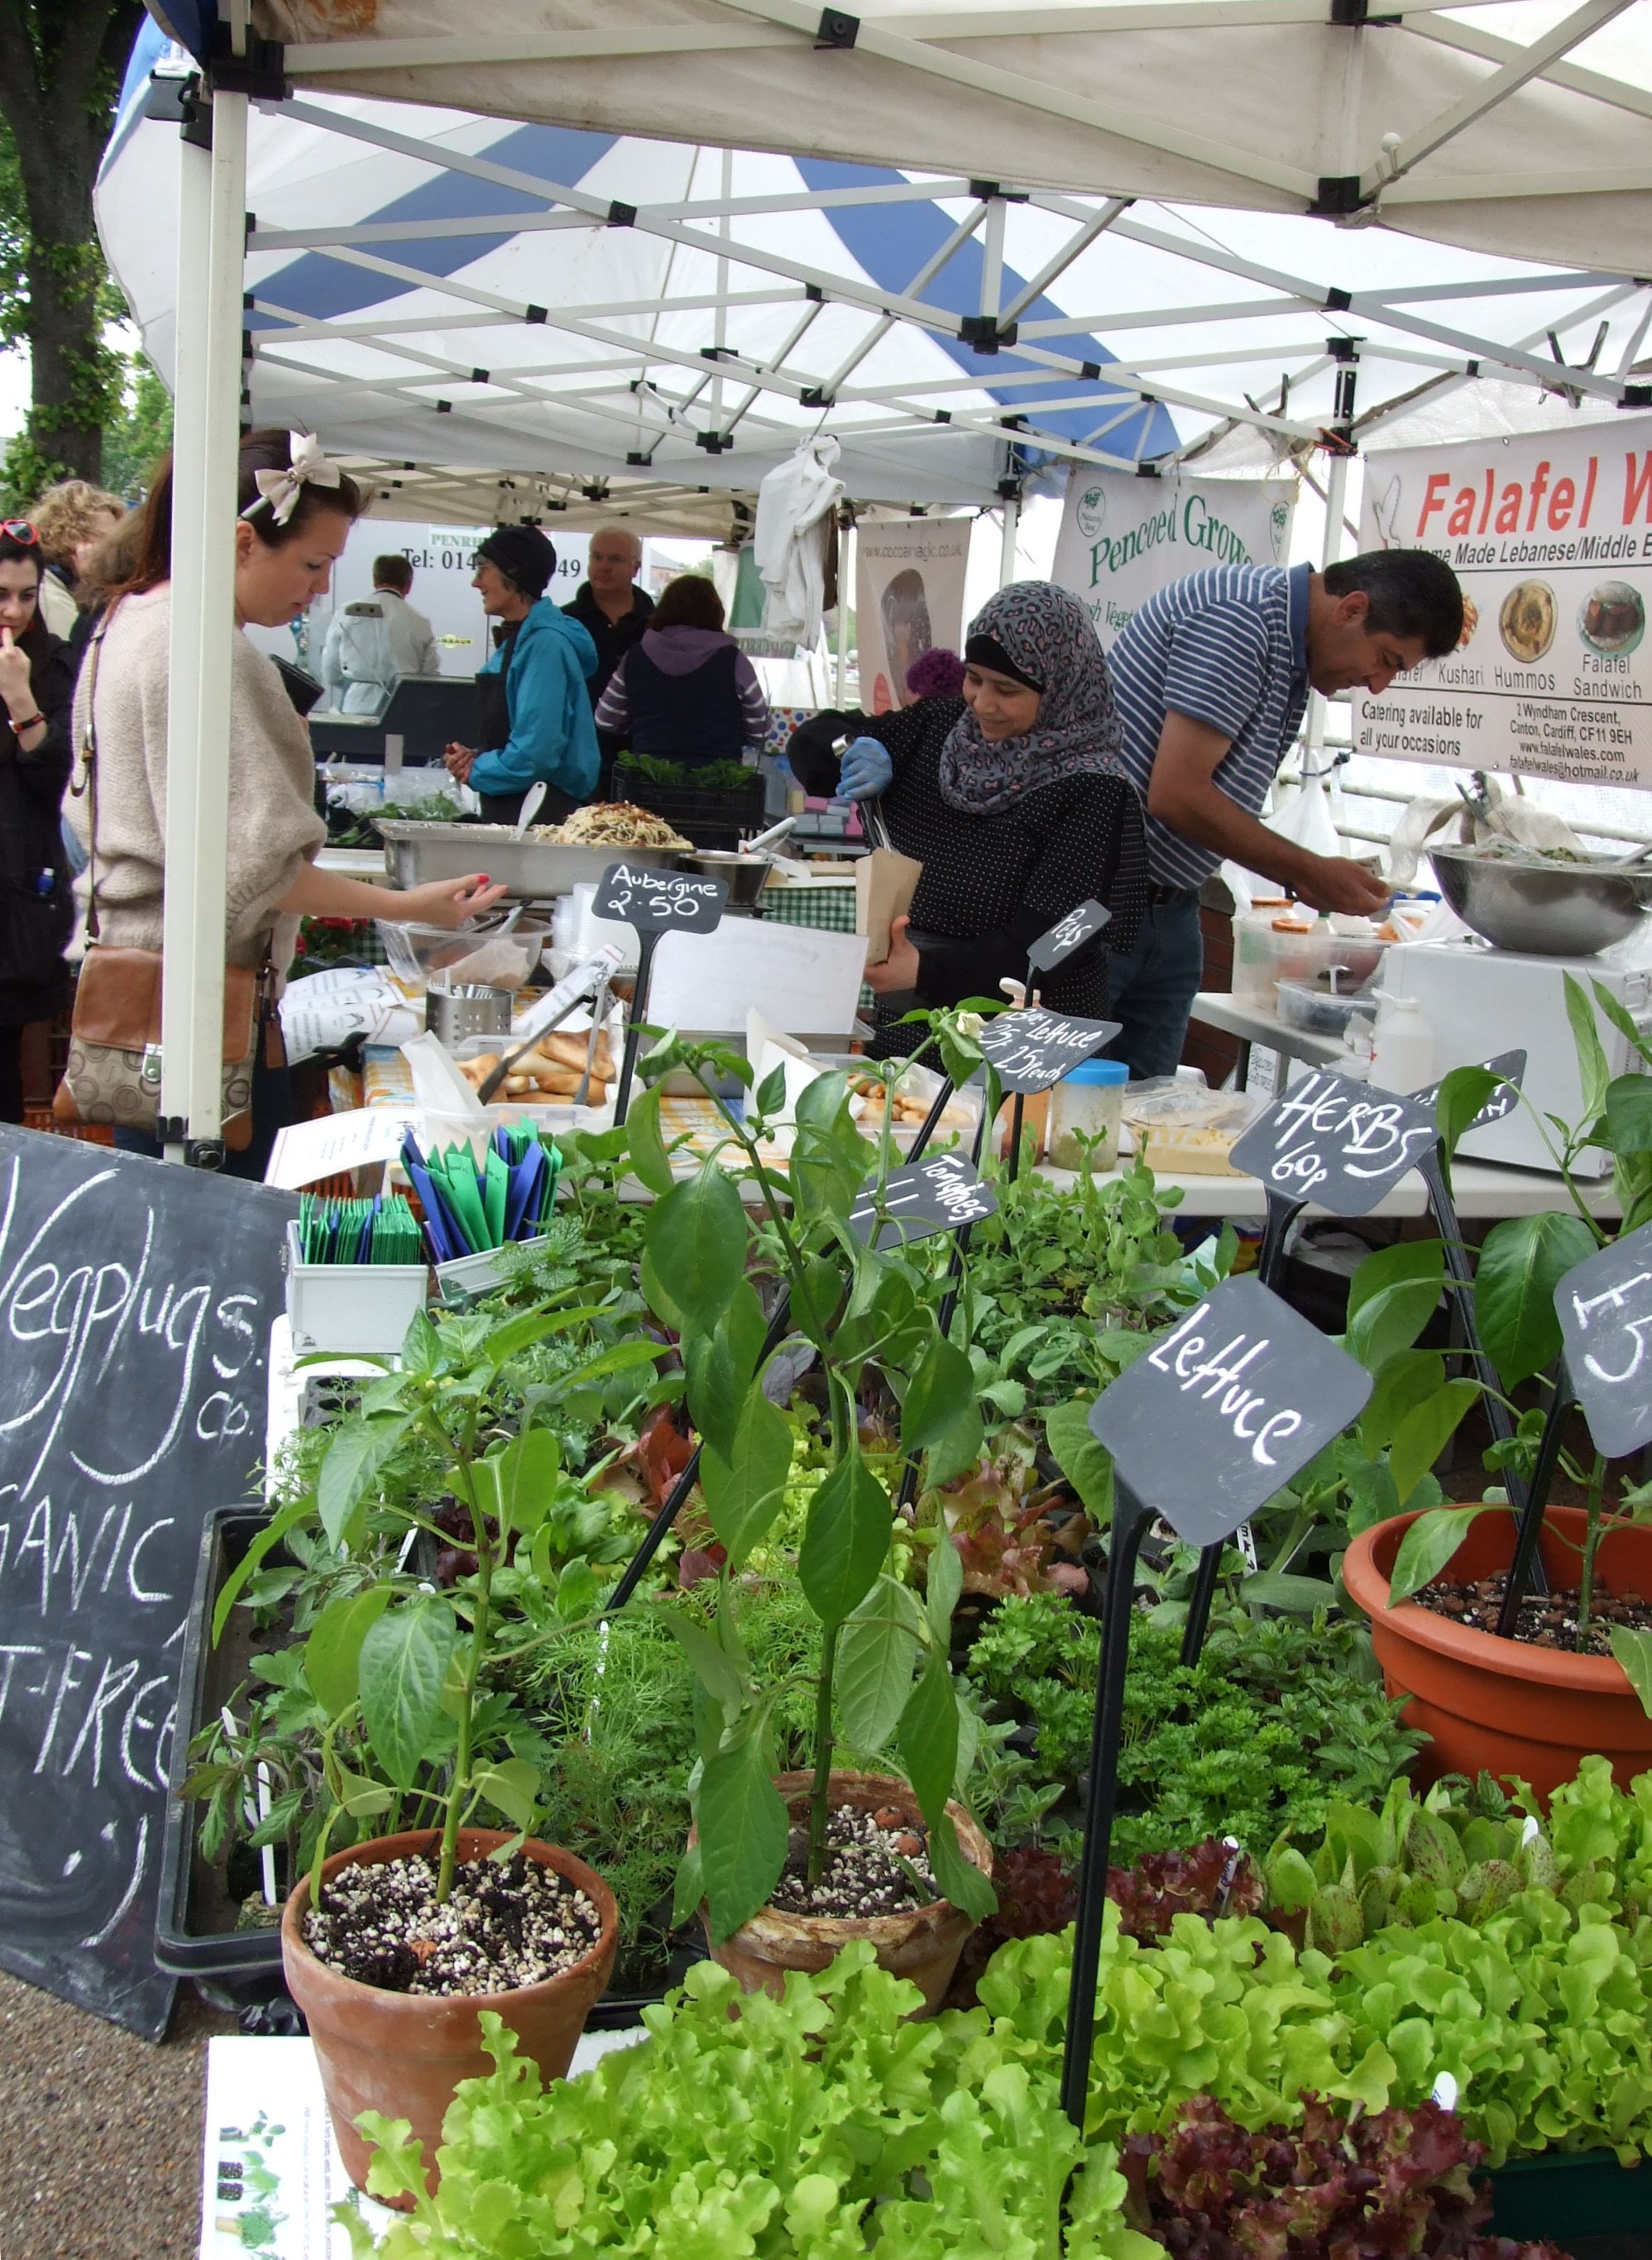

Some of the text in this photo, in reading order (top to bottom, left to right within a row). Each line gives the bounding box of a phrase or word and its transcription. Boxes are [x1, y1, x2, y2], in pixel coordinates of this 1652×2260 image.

[1415, 457, 1597, 537] Falafel
[1089, 494, 1177, 588] Pencoed
[1455, 543, 1496, 564] Made
[1500, 535, 1637, 563] Lebanese/Middle
[401, 548, 433, 567] Tel:
[558, 559, 581, 577] 49
[1439, 662, 1484, 686] Kushari
[1495, 665, 1555, 691] Hummos
[1583, 654, 1630, 674] Falafel
[1574, 678, 1642, 699] Sandwich
[1362, 701, 1483, 730] Catering available for
[1524, 703, 1567, 721] Wyndham
[1570, 707, 1621, 726] Crescent,
[1360, 727, 1462, 756] all your occasions
[1544, 724, 1577, 742] Cardiff,
[1579, 726, 1607, 743] CF11
[1610, 729, 1633, 745] 9EH
[1519, 741, 1626, 763] www.falafelwales.com
[611, 864, 718, 901] Aubergine
[1026, 1018, 1103, 1048] Lettuce
[1274, 1074, 1432, 1178] HERBS
[1271, 1141, 1328, 1194] 60p
[921, 1154, 989, 1221] Tomatoes
[1148, 1303, 1301, 1465] Lettuce
